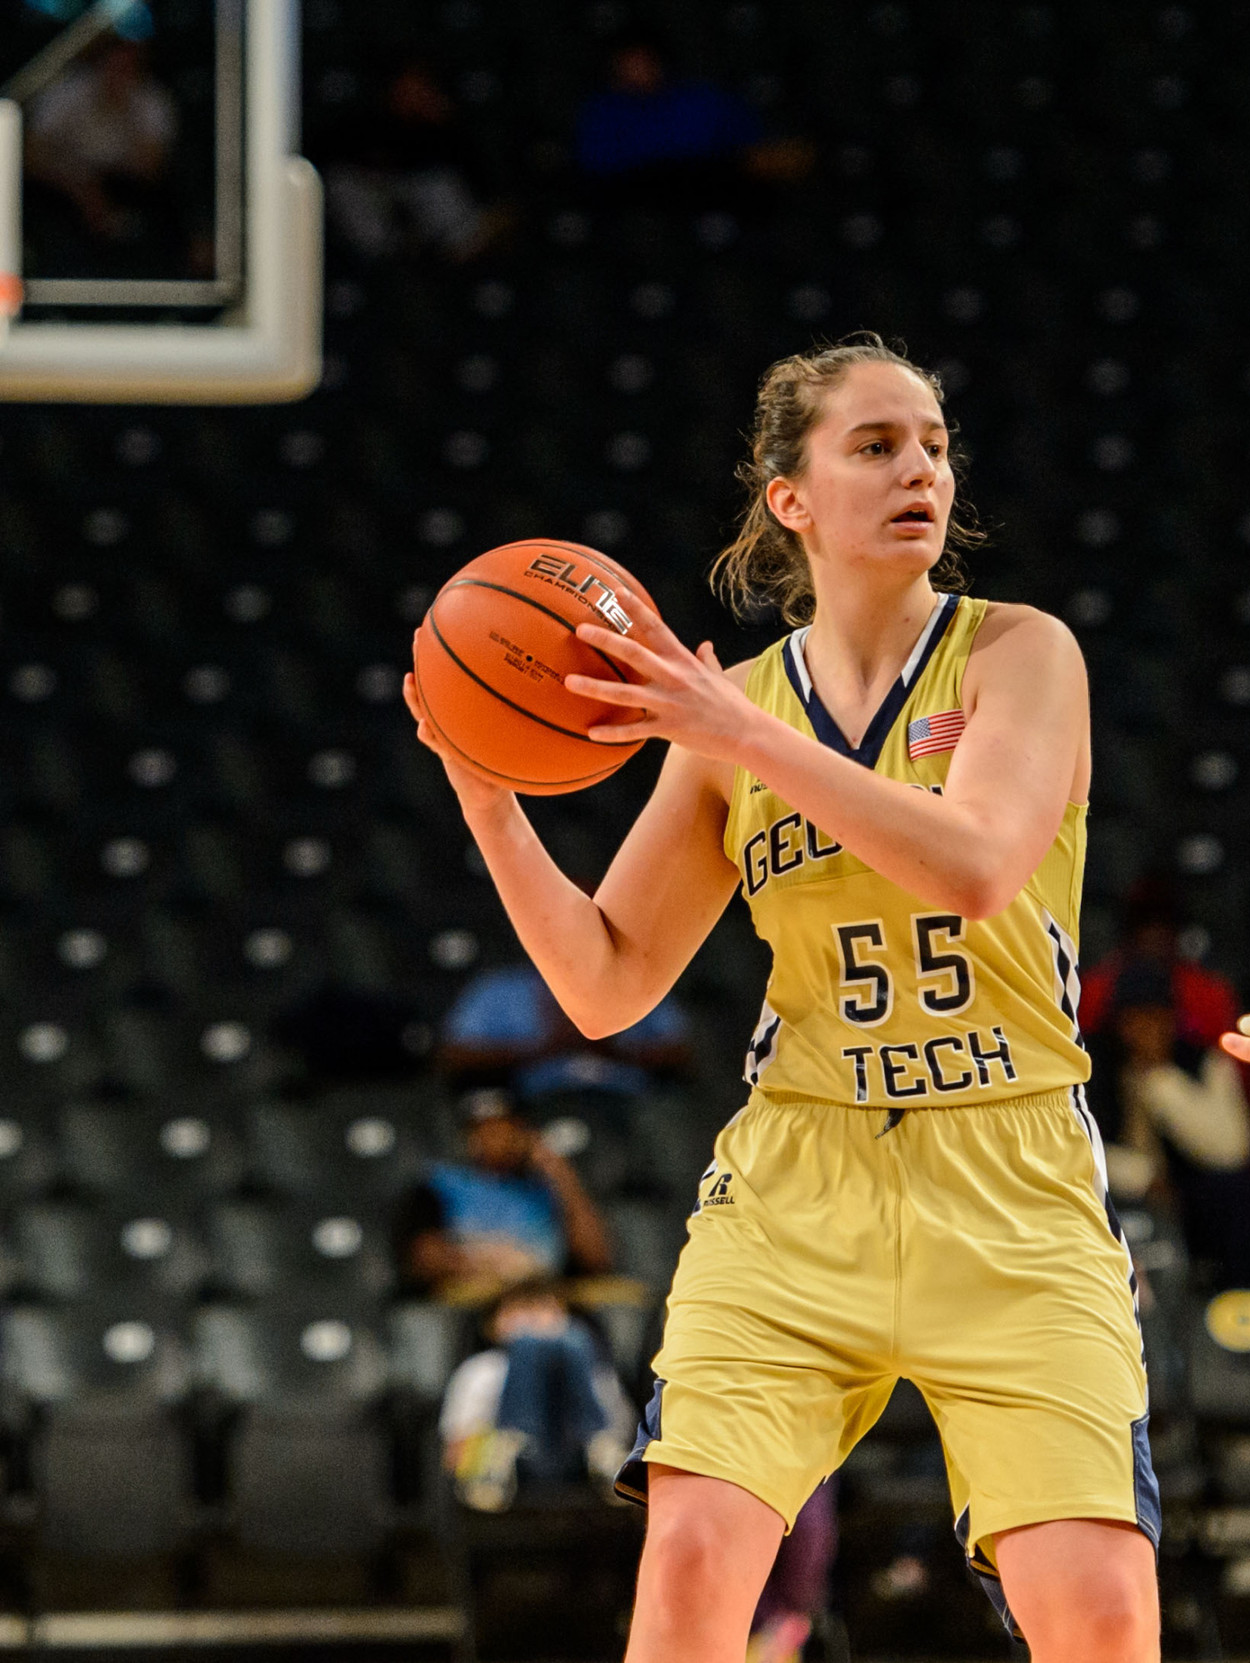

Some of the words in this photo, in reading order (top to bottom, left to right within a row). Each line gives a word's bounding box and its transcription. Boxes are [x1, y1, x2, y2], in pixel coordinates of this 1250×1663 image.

[528, 553, 633, 635] ELITE
[831, 911, 975, 1028] 55
[841, 1025, 1019, 1104] TECH
